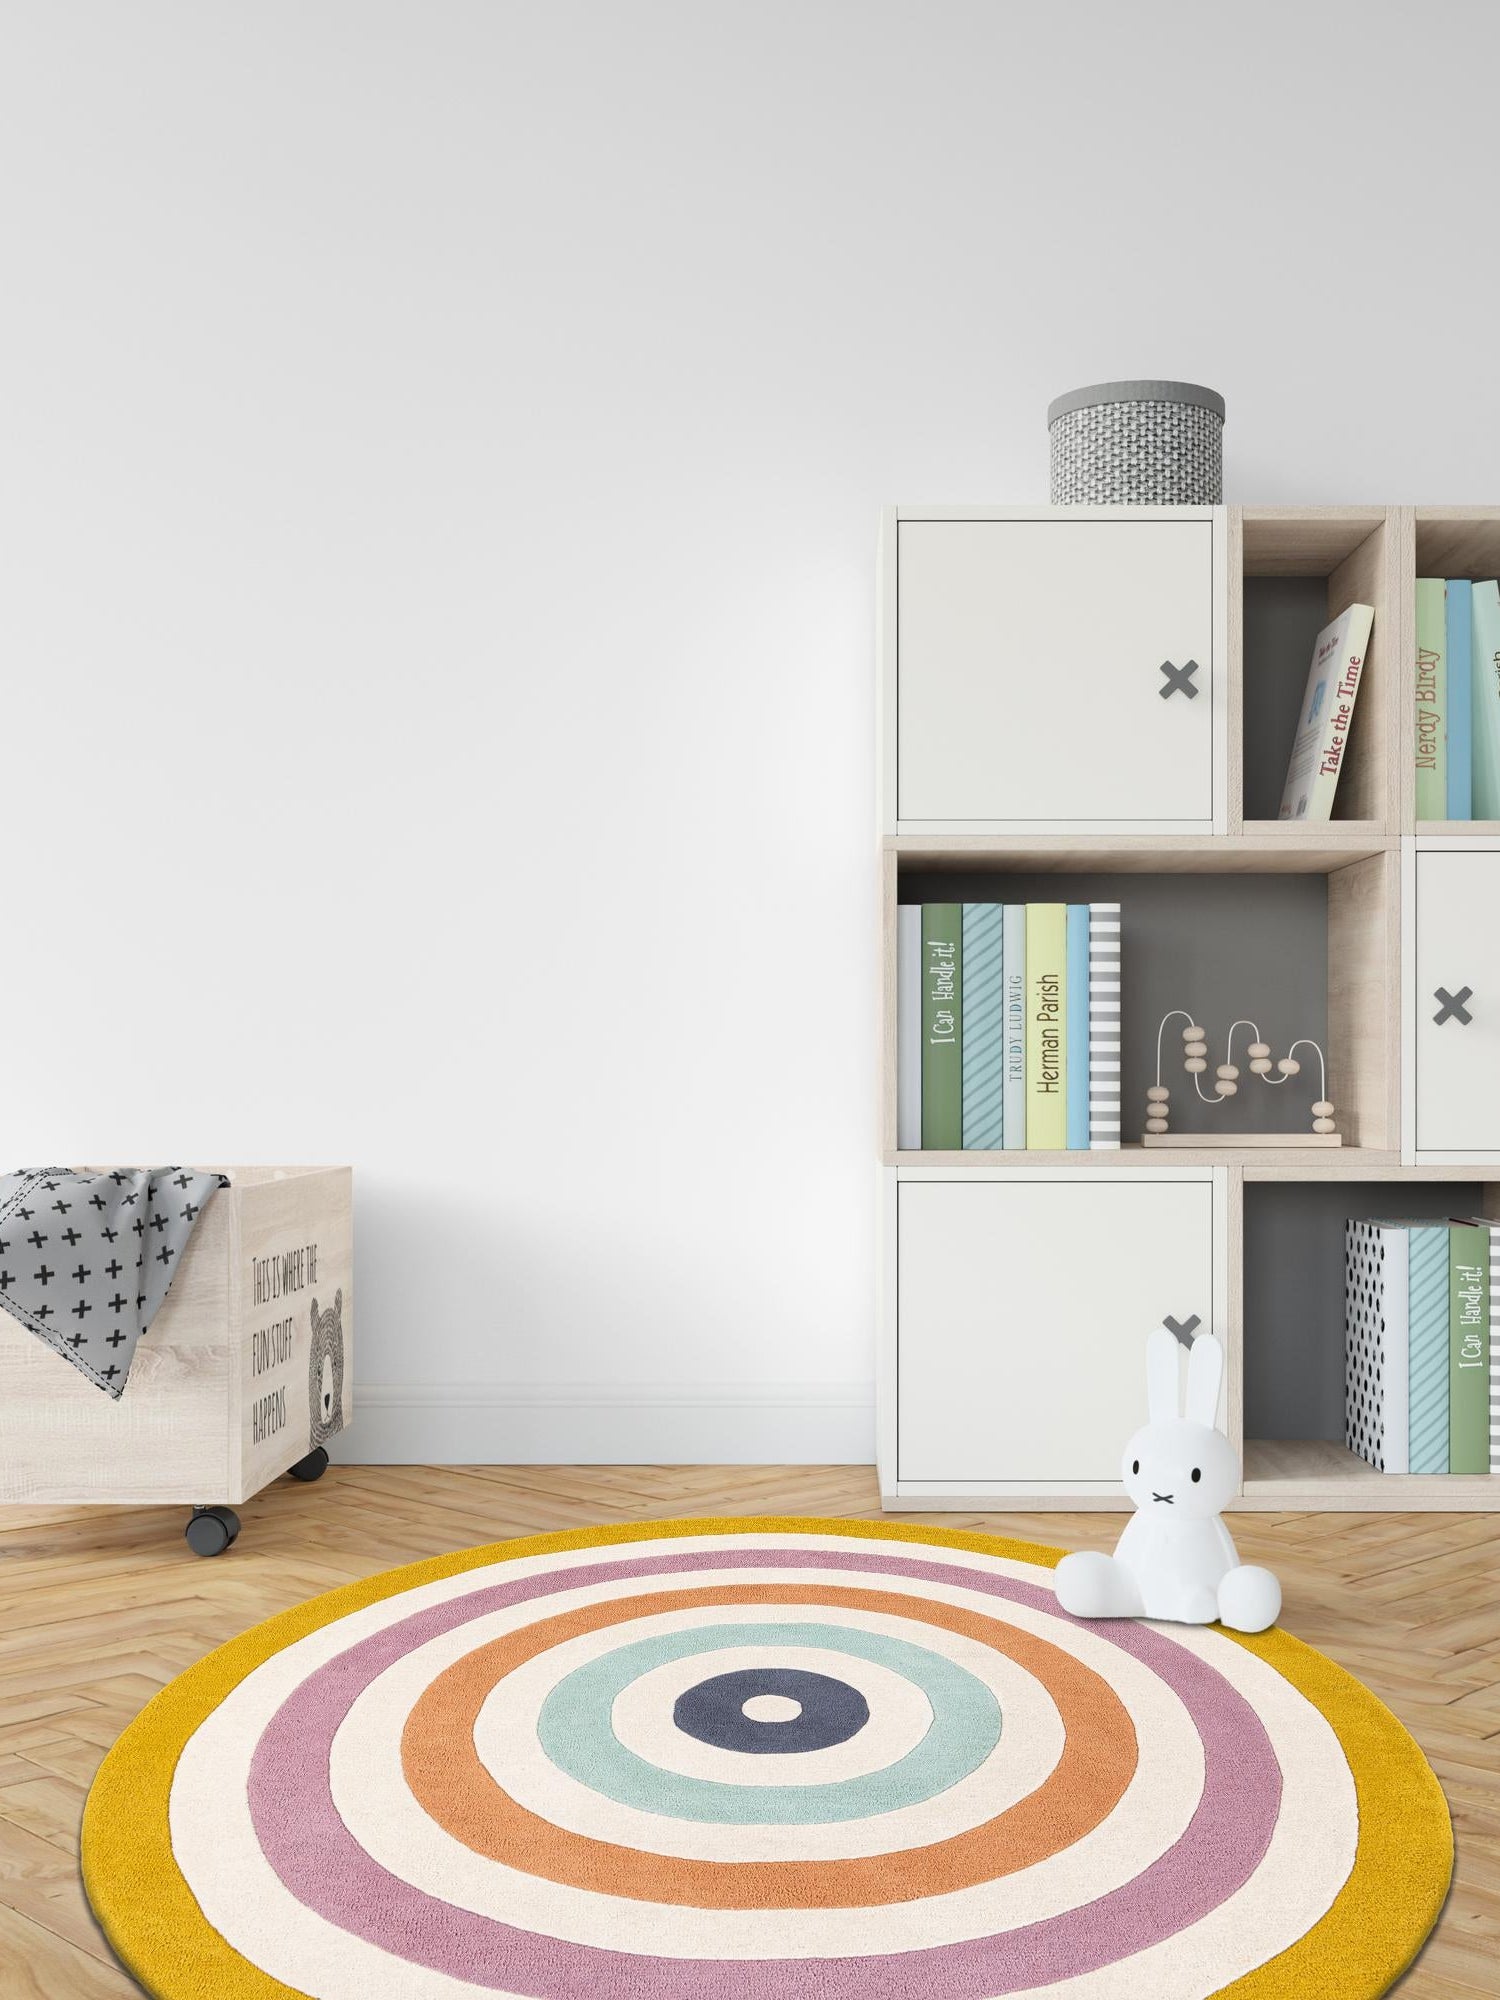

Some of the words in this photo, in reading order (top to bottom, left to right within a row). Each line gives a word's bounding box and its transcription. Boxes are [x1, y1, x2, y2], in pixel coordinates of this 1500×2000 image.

[1336, 655, 1361, 698] Time
[1331, 704, 1350, 731] the
[1319, 735, 1343, 776] Take
[1415, 710, 1440, 770] Nerdy
[927, 941, 956, 958] it!
[929, 960, 956, 1001] Handle
[1036, 974, 1059, 1022] Parish
[933, 1009, 955, 1034] Can
[1009, 975, 1022, 1030] LUDWIG
[930, 1037, 956, 1045] I
[1009, 1034, 1022, 1082] TRUDY
[1036, 1029, 1059, 1093] Herman
[252, 1257, 271, 1306] THIS
[272, 1255, 281, 1298] IS
[282, 1248, 304, 1296] WHERE
[306, 1244, 317, 1285] THE
[1455, 1265, 1483, 1282] it!
[1457, 1285, 1483, 1325] Handle
[252, 1329, 270, 1377] FUN
[271, 1317, 293, 1368] STUFF
[1460, 1334, 1482, 1359] Can
[252, 1385, 287, 1445] HAPPENS
